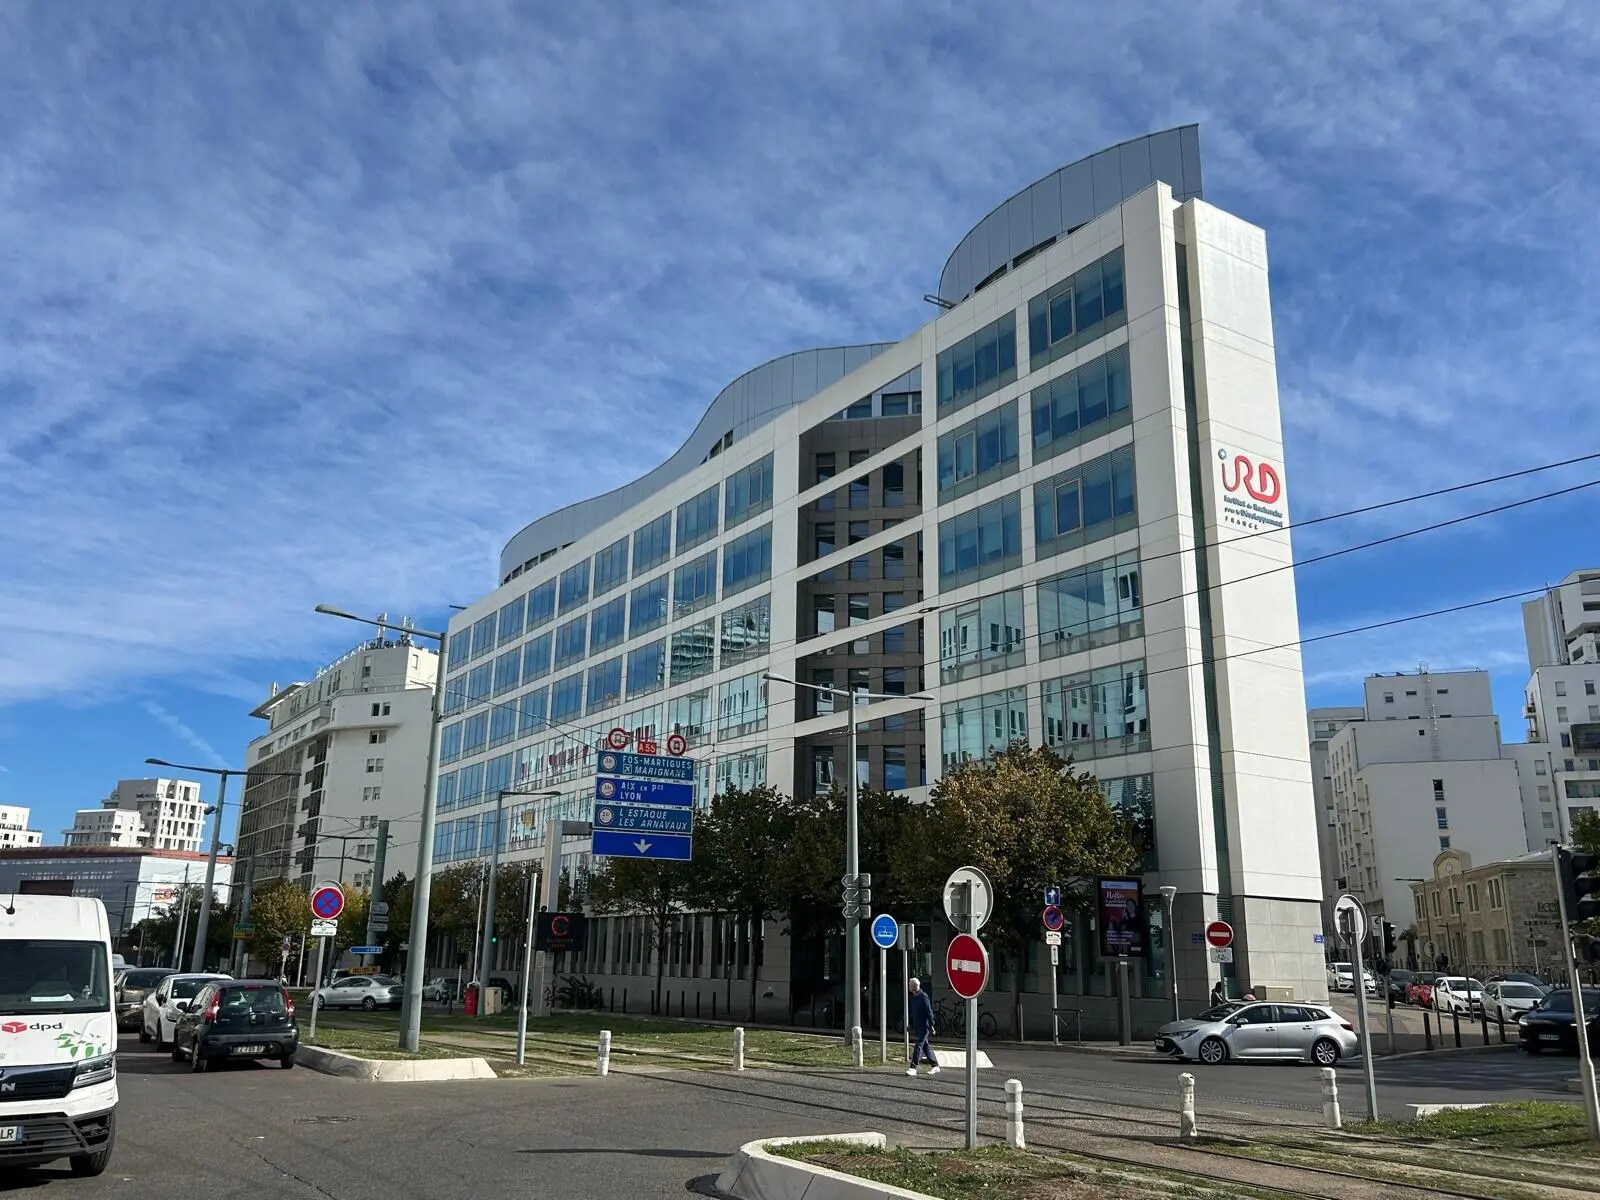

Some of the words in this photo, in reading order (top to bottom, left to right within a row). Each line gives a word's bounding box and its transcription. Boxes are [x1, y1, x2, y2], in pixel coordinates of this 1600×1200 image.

[1225, 516, 1259, 530] FRANCE
[622, 755, 692, 770] FOS-MARTIGUES
[634, 765, 686, 778] MARIGNANE
[621, 782, 636, 791] AIX
[620, 791, 642, 801] LYON
[618, 818, 635, 827] LES
[640, 819, 688, 830] ARNAVAUX
[29, 1022, 63, 1031] dpd
